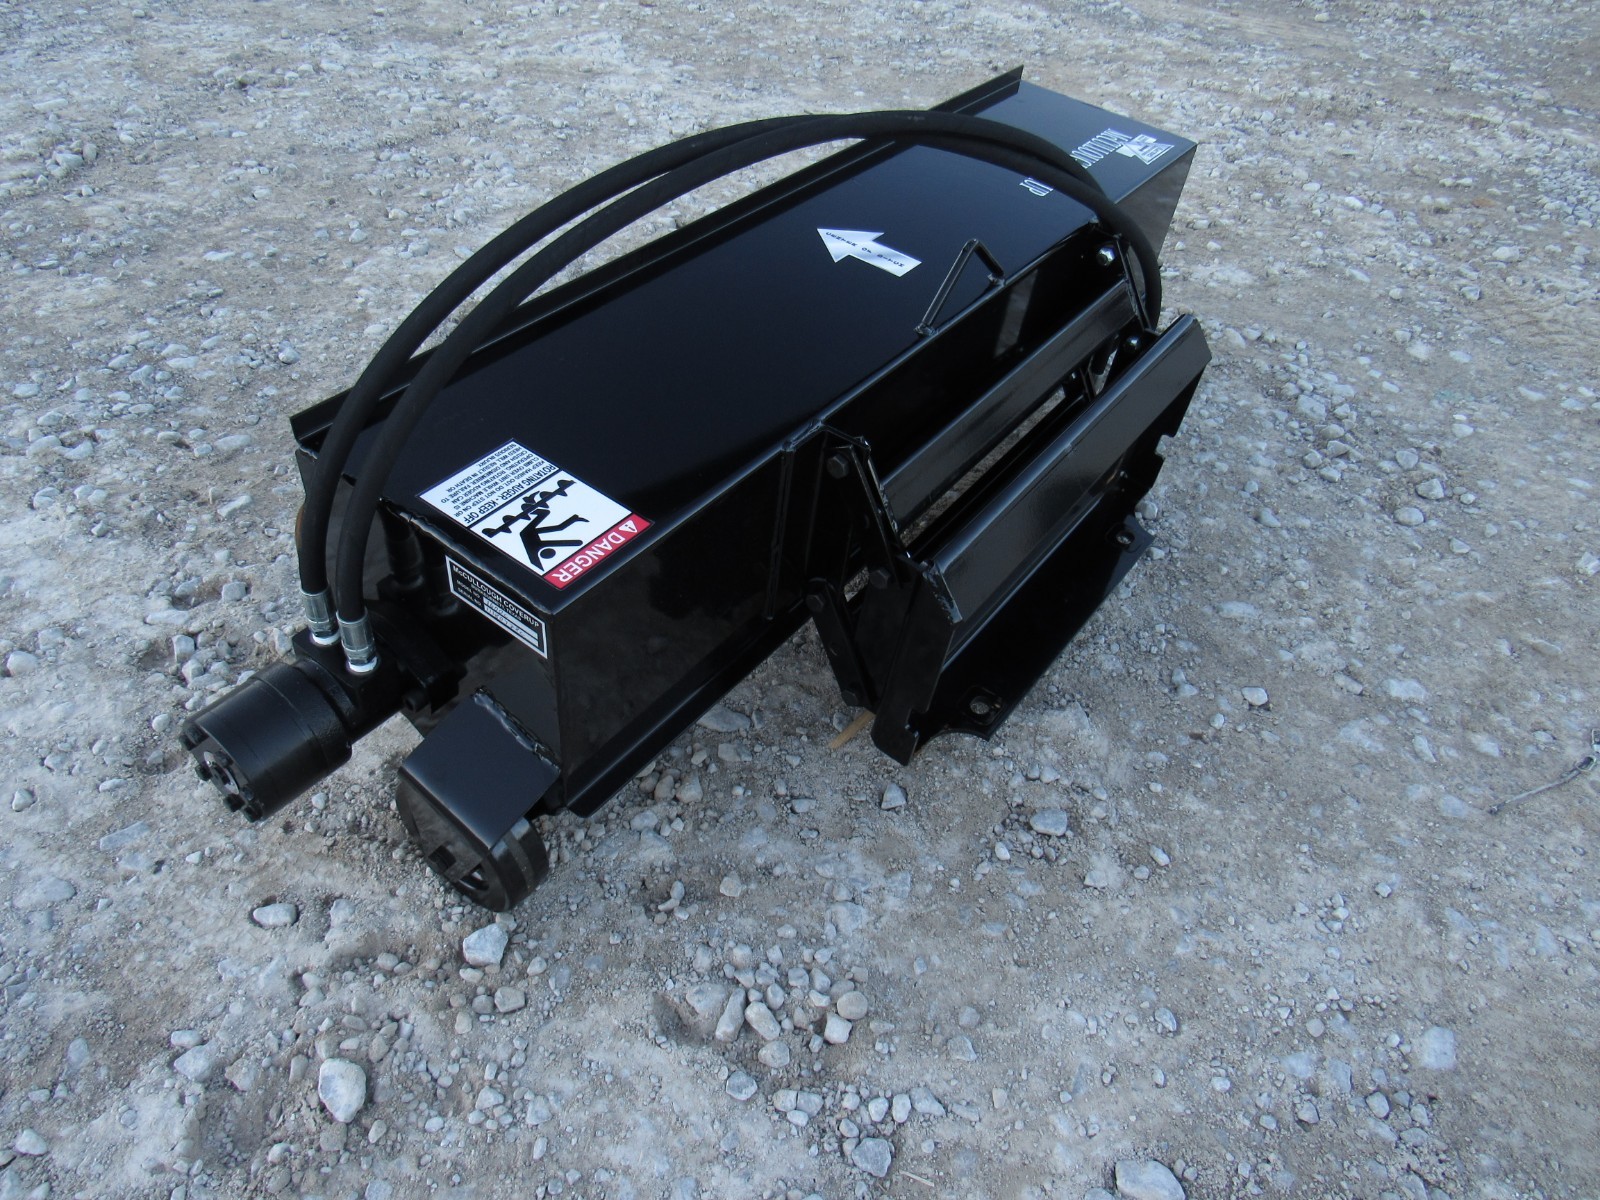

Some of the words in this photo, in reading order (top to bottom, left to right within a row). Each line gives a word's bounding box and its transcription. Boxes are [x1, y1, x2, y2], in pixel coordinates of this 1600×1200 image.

[1070, 128, 1132, 169] McCULLOUG
[493, 443, 517, 457] SERIOUS
[506, 446, 522, 456] HEED
[509, 450, 528, 461] CRUSH
[495, 454, 509, 462] WILL
[499, 459, 512, 467] AND
[522, 456, 540, 467] CLIMB
[476, 461, 497, 474] RESULT
[508, 465, 525, 475] OVER
[530, 460, 545, 469] KEEP
[479, 470, 506, 486] ROTATING
[497, 473, 511, 482] UNIT
[513, 467, 532, 479] HANDS
[520, 463, 556, 486] ROTATING
[453, 475, 473, 487] DEATH
[481, 481, 499, 492] WHILE
[447, 484, 471, 498] FAILURE
[461, 484, 482, 497] AUGER
[483, 490, 496, 498] NOT
[497, 482, 526, 500] AUGER
[450, 495, 464, 503] CAN
[458, 490, 483, 505] MACHINE
[469, 497, 485, 506] STEP
[474, 499, 498, 514] KEEP
[460, 510, 480, 523] OFF
[550, 530, 626, 583] DANGER
[452, 565, 502, 603] McCULLOUGH
[503, 600, 540, 627] COVERUP
